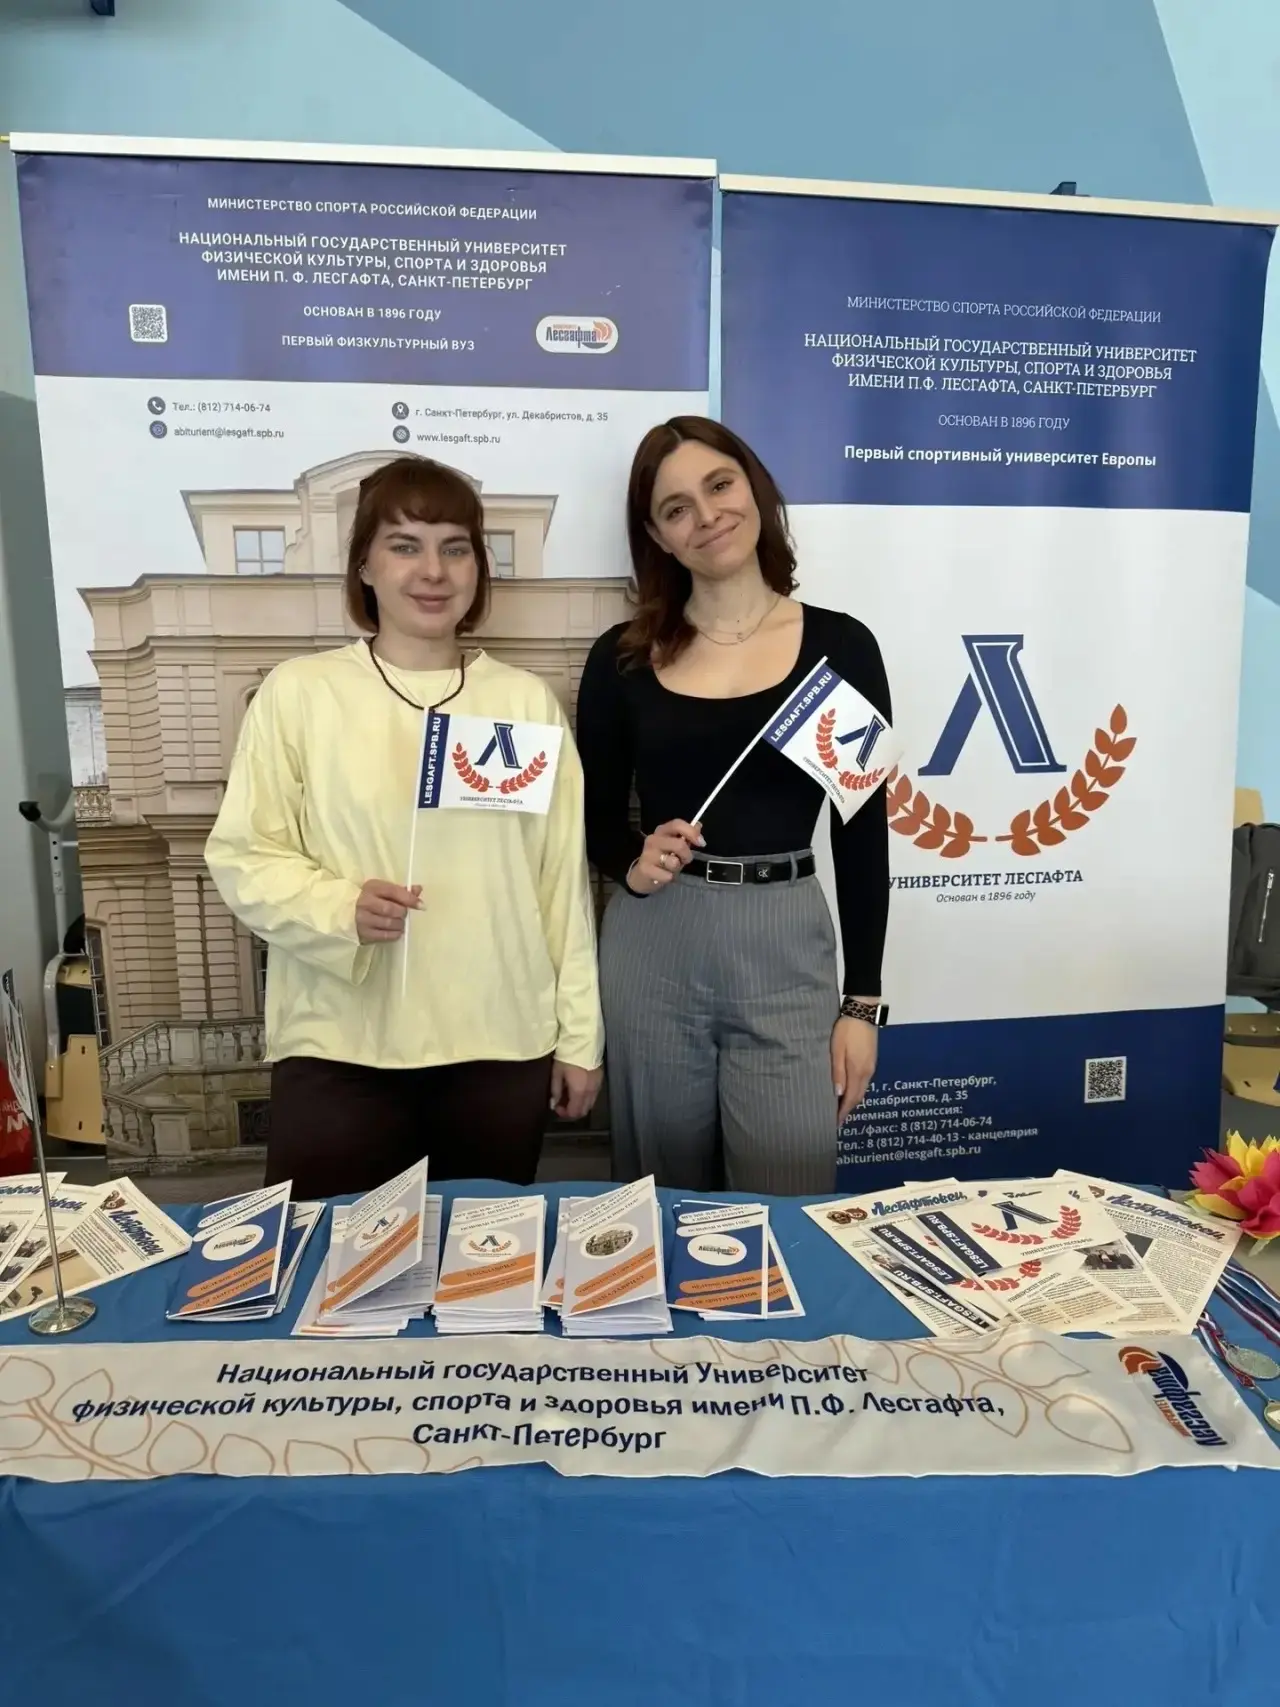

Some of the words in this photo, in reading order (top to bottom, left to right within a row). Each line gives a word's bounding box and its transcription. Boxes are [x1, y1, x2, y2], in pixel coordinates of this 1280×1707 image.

[207, 197, 312, 212] МИНИСТЕРСТВО
[315, 201, 368, 214] СПОРТА
[370, 203, 456, 217] РОССИЙСКОЙ
[459, 207, 537, 221] ФЕДЕРАЦИИ
[178, 231, 307, 248] НАЦИОНАЛЬНЫЙ
[311, 236, 460, 253] ГОСУДАРСТВЕННЫЙ
[464, 241, 567, 256] УНИВЕРСИТЕТ
[201, 250, 303, 265] ФИЗИЧЕСКОЙ
[307, 254, 391, 269] КУЛЬТУРЫ,
[394, 257, 453, 271] СПОРТА
[456, 259, 466, 271] И
[470, 259, 547, 273] ЗДОРОВЬЯ
[217, 269, 270, 282] ИМЕНИ
[274, 270, 289, 283] П.
[292, 270, 308, 284] Ф.
[312, 272, 395, 287] ЛЕСГАФТА,
[398, 275, 533, 290] САНКТ-ПЕТЕРБУРГ
[303, 306, 364, 317] ОСНОВАН
[367, 307, 375, 318] В
[378, 308, 406, 319] 1896
[408, 309, 442, 321] ГОДУ
[847, 296, 950, 312] МИНИСТЕРСТВО
[952, 301, 1001, 315] СПОРТА
[1003, 303, 1086, 319] РОССИЙСКОЙ
[1088, 308, 1161, 323] ФЕДЕРАЦИИ
[281, 334, 334, 347] ПЕРВЫЙ
[337, 336, 448, 350] ФИЗКУЛЬТУРНЫЙ
[451, 340, 475, 351] ВУЗ
[804, 333, 941, 351] НАЦИОНАЛЬНЫЙ
[943, 338, 1092, 358] ГОСУДАРСТВЕННЫЙ
[1095, 345, 1197, 362] УНИВЕРСИТЕТ
[831, 353, 936, 371] ФИЗИЧЕСКОЙ
[939, 358, 1021, 375] КУЛЬТУРЫ,
[1024, 361, 1081, 376] СПОРТА
[1084, 364, 1095, 377] И
[1097, 365, 1172, 380] ЗДОРОВЬЯ
[848, 373, 905, 389] ИМЕНИ
[908, 376, 938, 390] П.Ф.
[941, 377, 1020, 395] ЛЕСГАФТА,
[1023, 380, 1157, 398] САНКТ-ПЕТЕРБУРГ
[172, 402, 196, 411] Тел.:
[197, 402, 222, 413] (812)
[223, 402, 271, 412] 714-06-74
[415, 409, 423, 417] г.
[424, 408, 505, 423] Санкт-Петербург,
[506, 411, 520, 422] ул.
[521, 410, 585, 423] Декабристов,
[586, 413, 595, 422] д.
[596, 412, 609, 421] 35
[173, 428, 285, 440] abiturient@lesgaft.spb.ru
[938, 414, 999, 428] ОСНОВАН
[1000, 416, 1009, 428] В
[1011, 416, 1036, 429] 1896
[1038, 417, 1070, 431] ГОДУ
[416, 432, 501, 445] www.lesgaft.spb.ru
[844, 444, 904, 461] Первый
[907, 447, 1002, 464] спортивный
[1005, 449, 1099, 466] университет
[1102, 452, 1157, 469] Европы
[769, 671, 833, 743] LESGAFT.SPB.RU
[423, 716, 442, 804] LESGAFT.SPB.RU
[888, 872, 1001, 890] УНИВЕРСИТЕТ
[1004, 869, 1084, 886] ЛЕСГАФТА
[936, 892, 978, 903] Основан
[980, 893, 987, 902] в
[988, 891, 1013, 902] 1896
[1014, 890, 1036, 903] году
[882, 1082, 892, 1092] г.
[894, 1075, 997, 1091] Санкт-Петербург,
[941, 1093, 953, 1104] д.
[955, 1090, 969, 1100] 35
[845, 1110, 899, 1125] риемная
[901, 1106, 963, 1118] комиссия:
[900, 1122, 908, 1132] 8
[910, 1120, 938, 1133] (812)
[940, 1116, 993, 1129] 714-06-74
[867, 1138, 874, 1149] 8
[876, 1136, 904, 1150] (812)
[907, 1132, 959, 1145] 714-40-13
[968, 1127, 1039, 1141] канцелярия
[836, 1145, 982, 1166] abiturient@lesgaft.spb.ru
[926, 1213, 989, 1270] LESGAFT.SPB.RU
[878, 1227, 954, 1283] LESGAFT.SPB.RU
[893, 1268, 986, 1326] LESGAFT.SPB.RU
[216, 1360, 436, 1385] Национальный
[443, 1361, 689, 1386] государственный
[695, 1361, 869, 1384] Университет
[72, 1392, 256, 1423] физической
[262, 1393, 403, 1417] культуры,
[412, 1391, 511, 1414] спорта
[520, 1396, 537, 1412] и
[544, 1394, 683, 1418] здоровья
[691, 1391, 785, 1416] имени
[863, 1390, 1005, 1417] Лесгафта,
[412, 1423, 667, 1453] Санкт-Петербург
